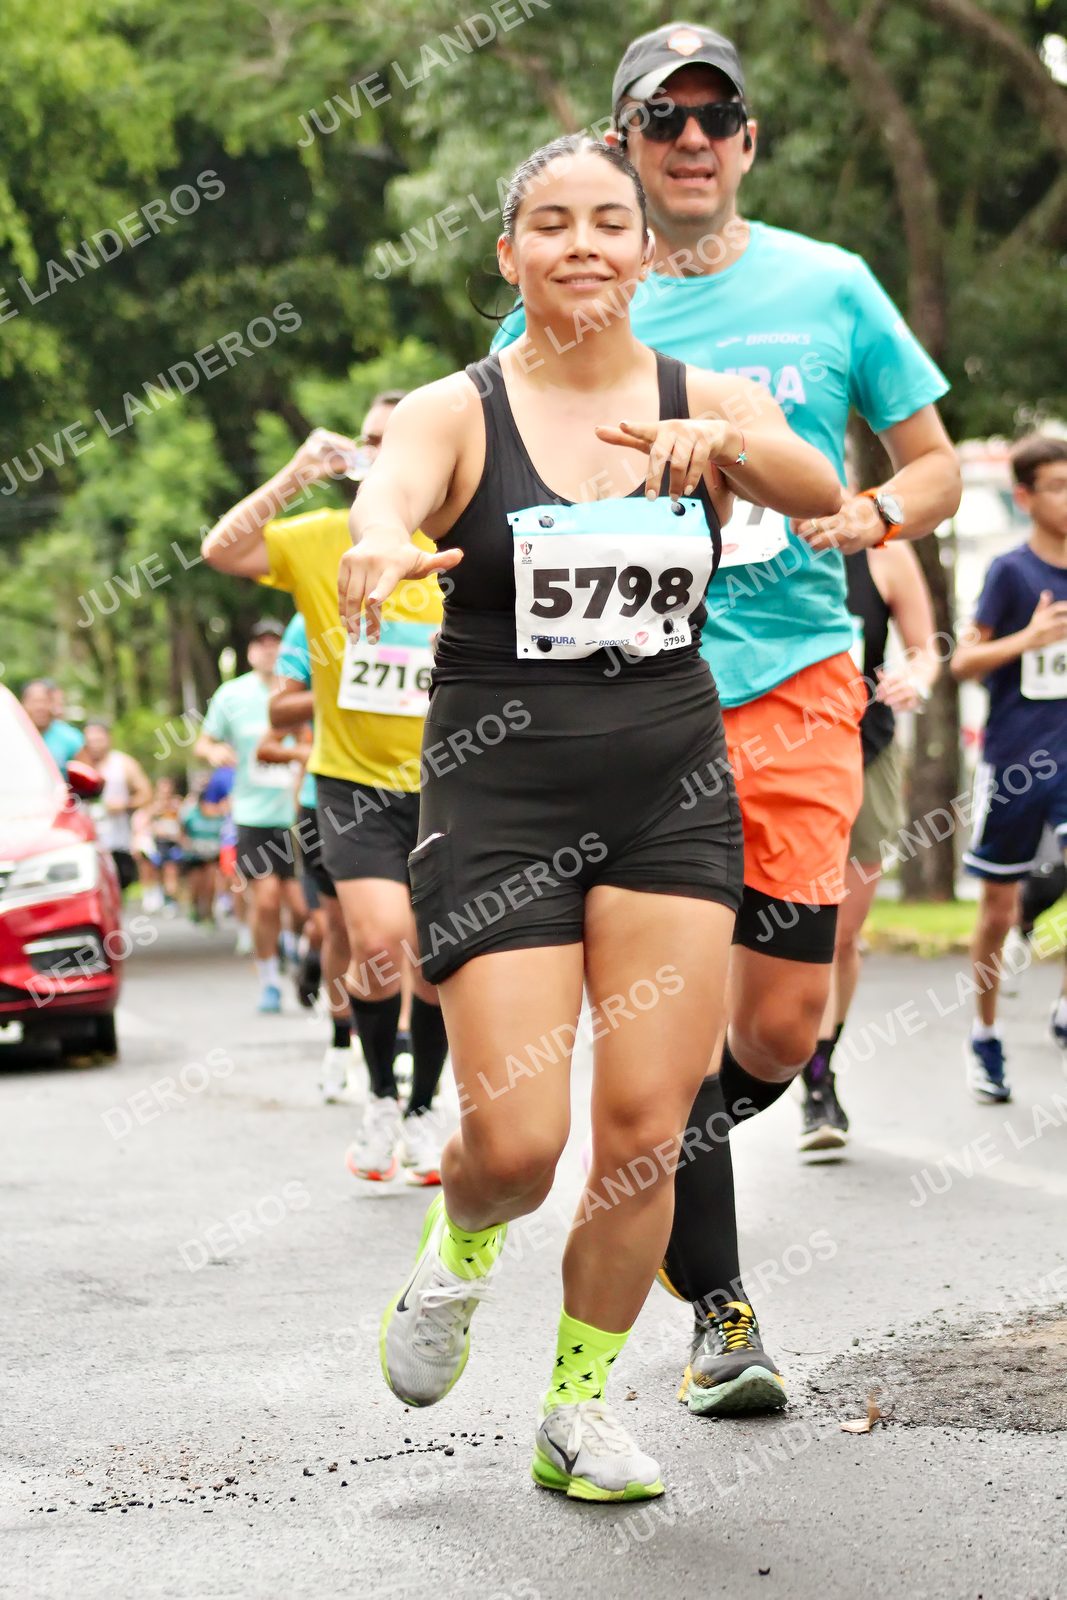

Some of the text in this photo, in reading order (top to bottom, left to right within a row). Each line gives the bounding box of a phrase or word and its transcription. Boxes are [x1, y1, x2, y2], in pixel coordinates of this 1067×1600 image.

[745, 333, 811, 345] BROOKS
[530, 565, 694, 619] 5798
[598, 638, 631, 647] BROOKS
[664, 634, 686, 648] 5798
[351, 660, 432, 691] 2716
